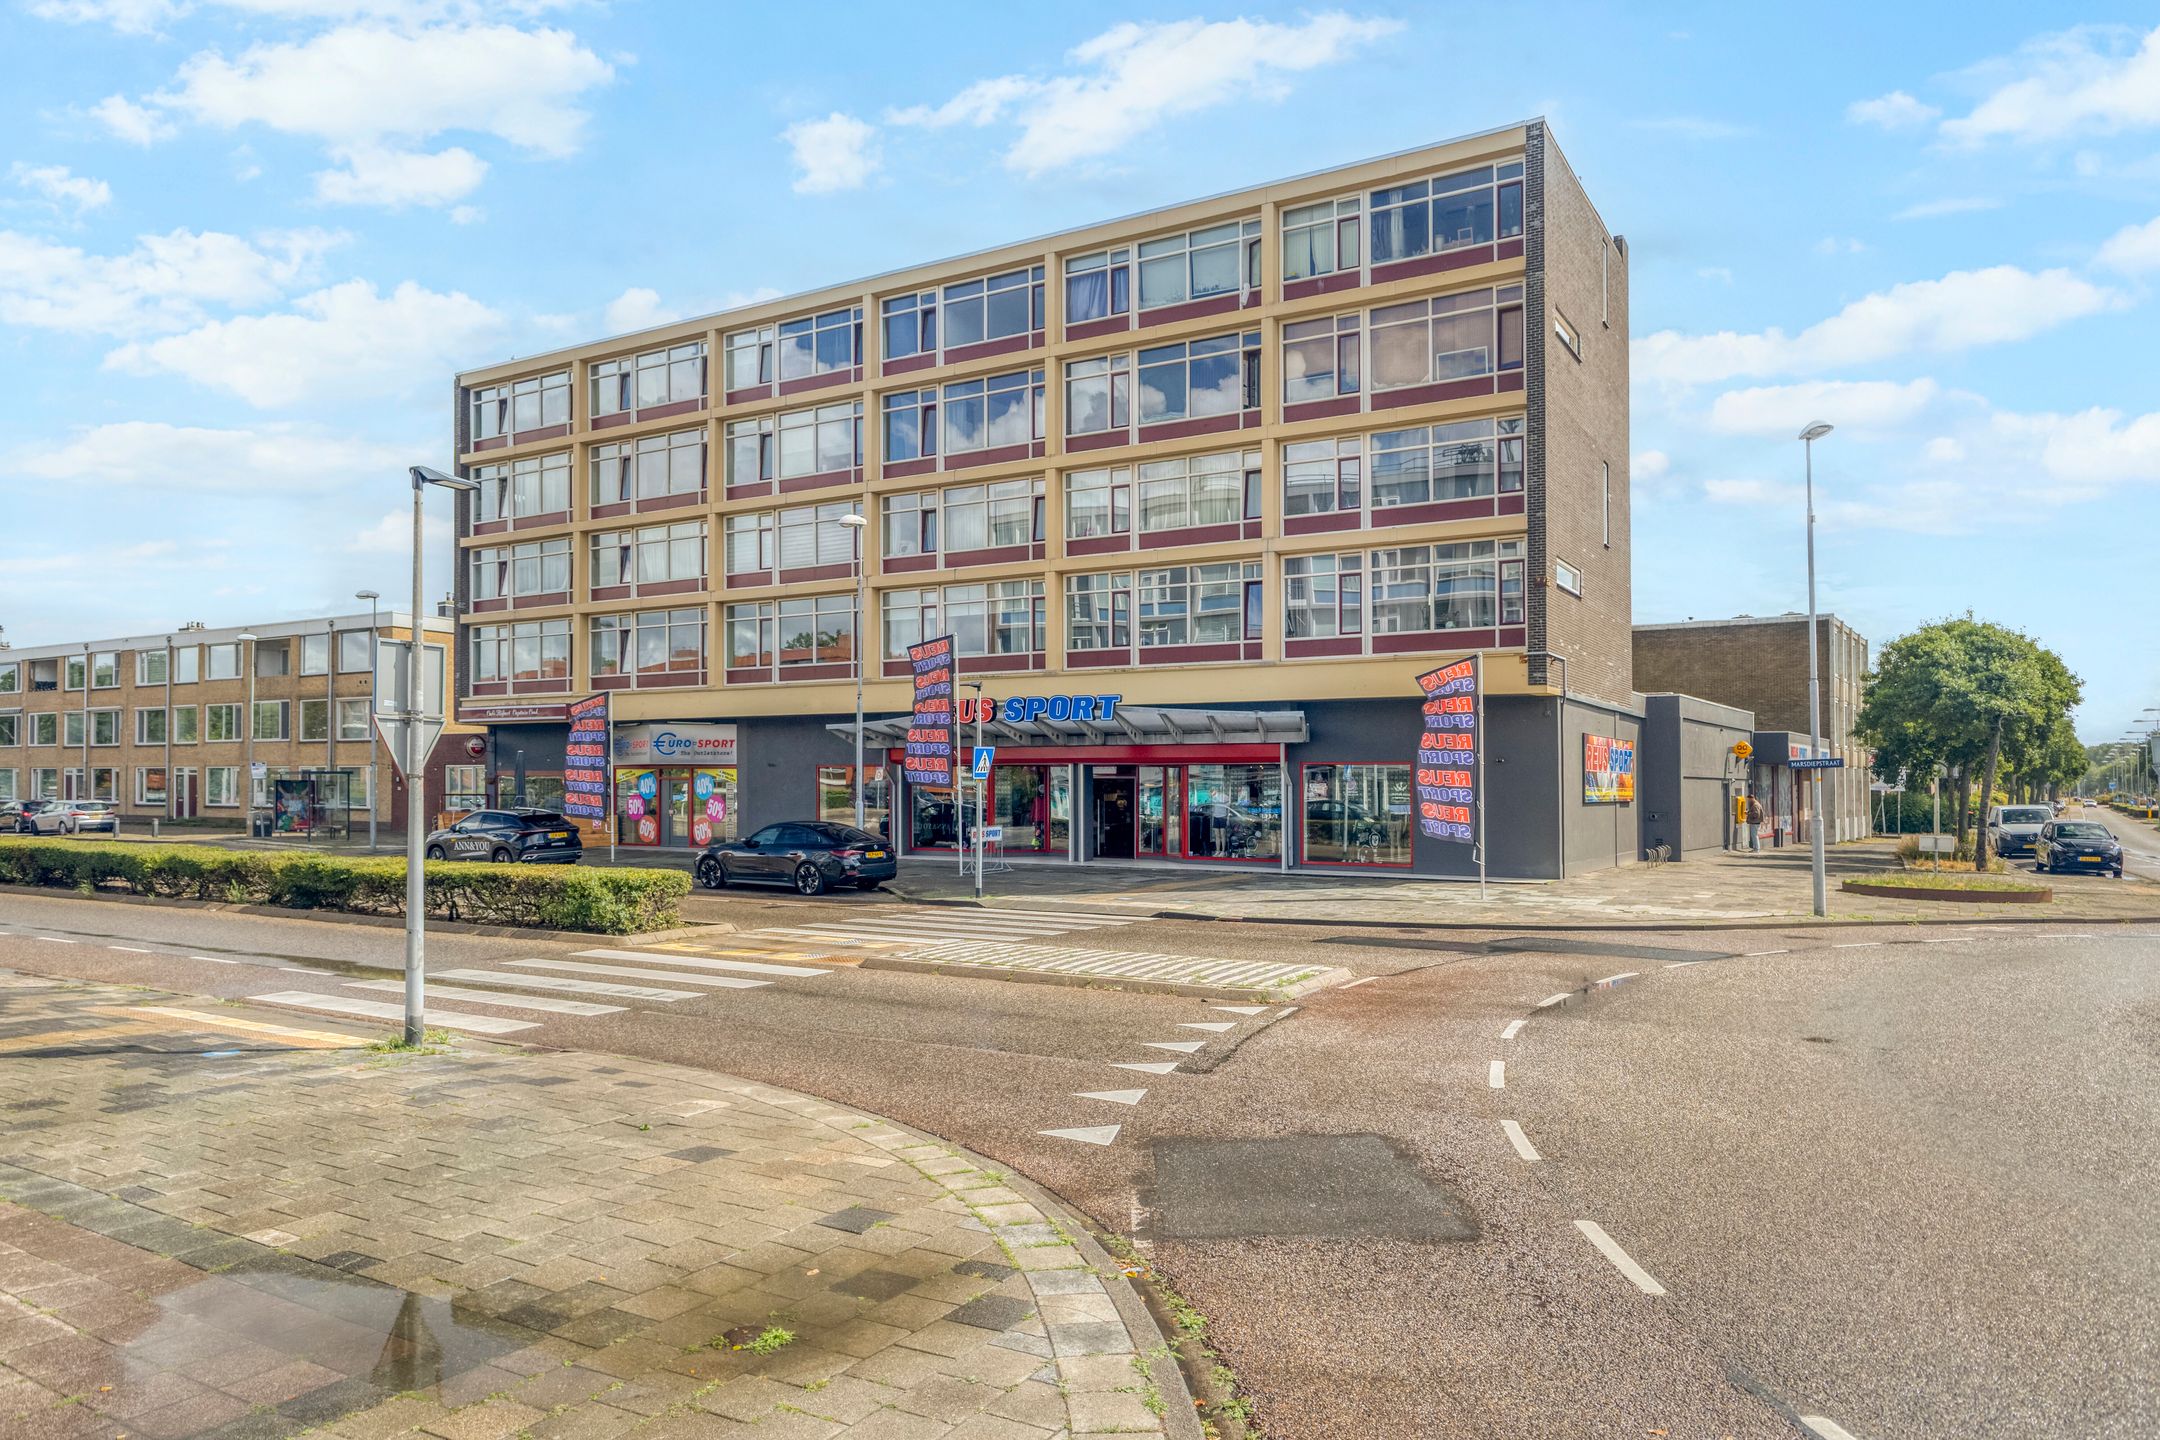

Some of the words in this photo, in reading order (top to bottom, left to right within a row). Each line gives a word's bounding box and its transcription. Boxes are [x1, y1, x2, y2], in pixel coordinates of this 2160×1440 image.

[1004, 694, 1121, 722] SPORT
[1586, 744, 1608, 772] REUS
[1609, 747, 1633, 773] SPORT
[641, 775, 656, 794] 40%
[697, 775, 712, 794] 40%
[628, 798, 644, 815] 50%
[707, 799, 724, 819] 50%
[640, 820, 655, 839] 60%
[694, 822, 711, 841] 60%
[454, 841, 490, 850] ANN&YOU
